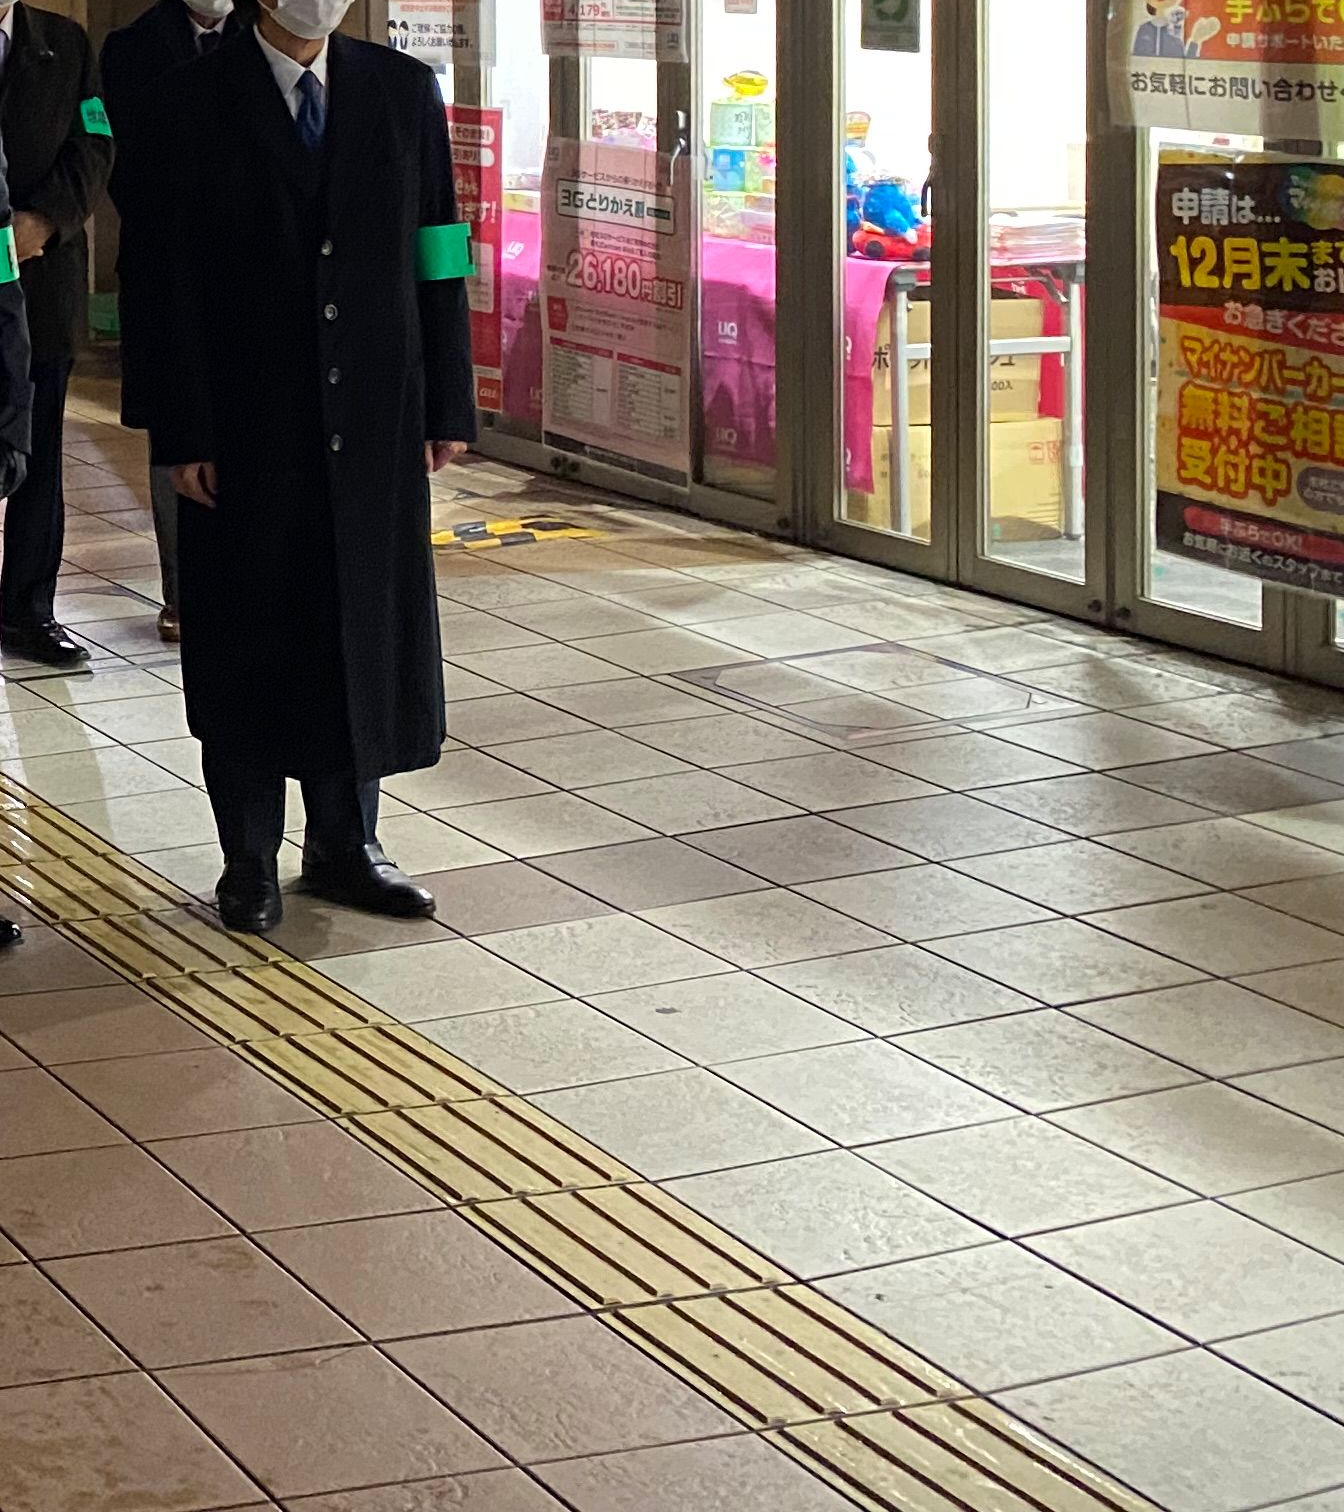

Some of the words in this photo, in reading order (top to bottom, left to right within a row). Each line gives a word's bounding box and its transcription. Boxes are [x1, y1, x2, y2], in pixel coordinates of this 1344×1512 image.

[1131, 72, 1344, 102] お気軽にお問い合わせ
[718, 321, 738, 338] UQ
